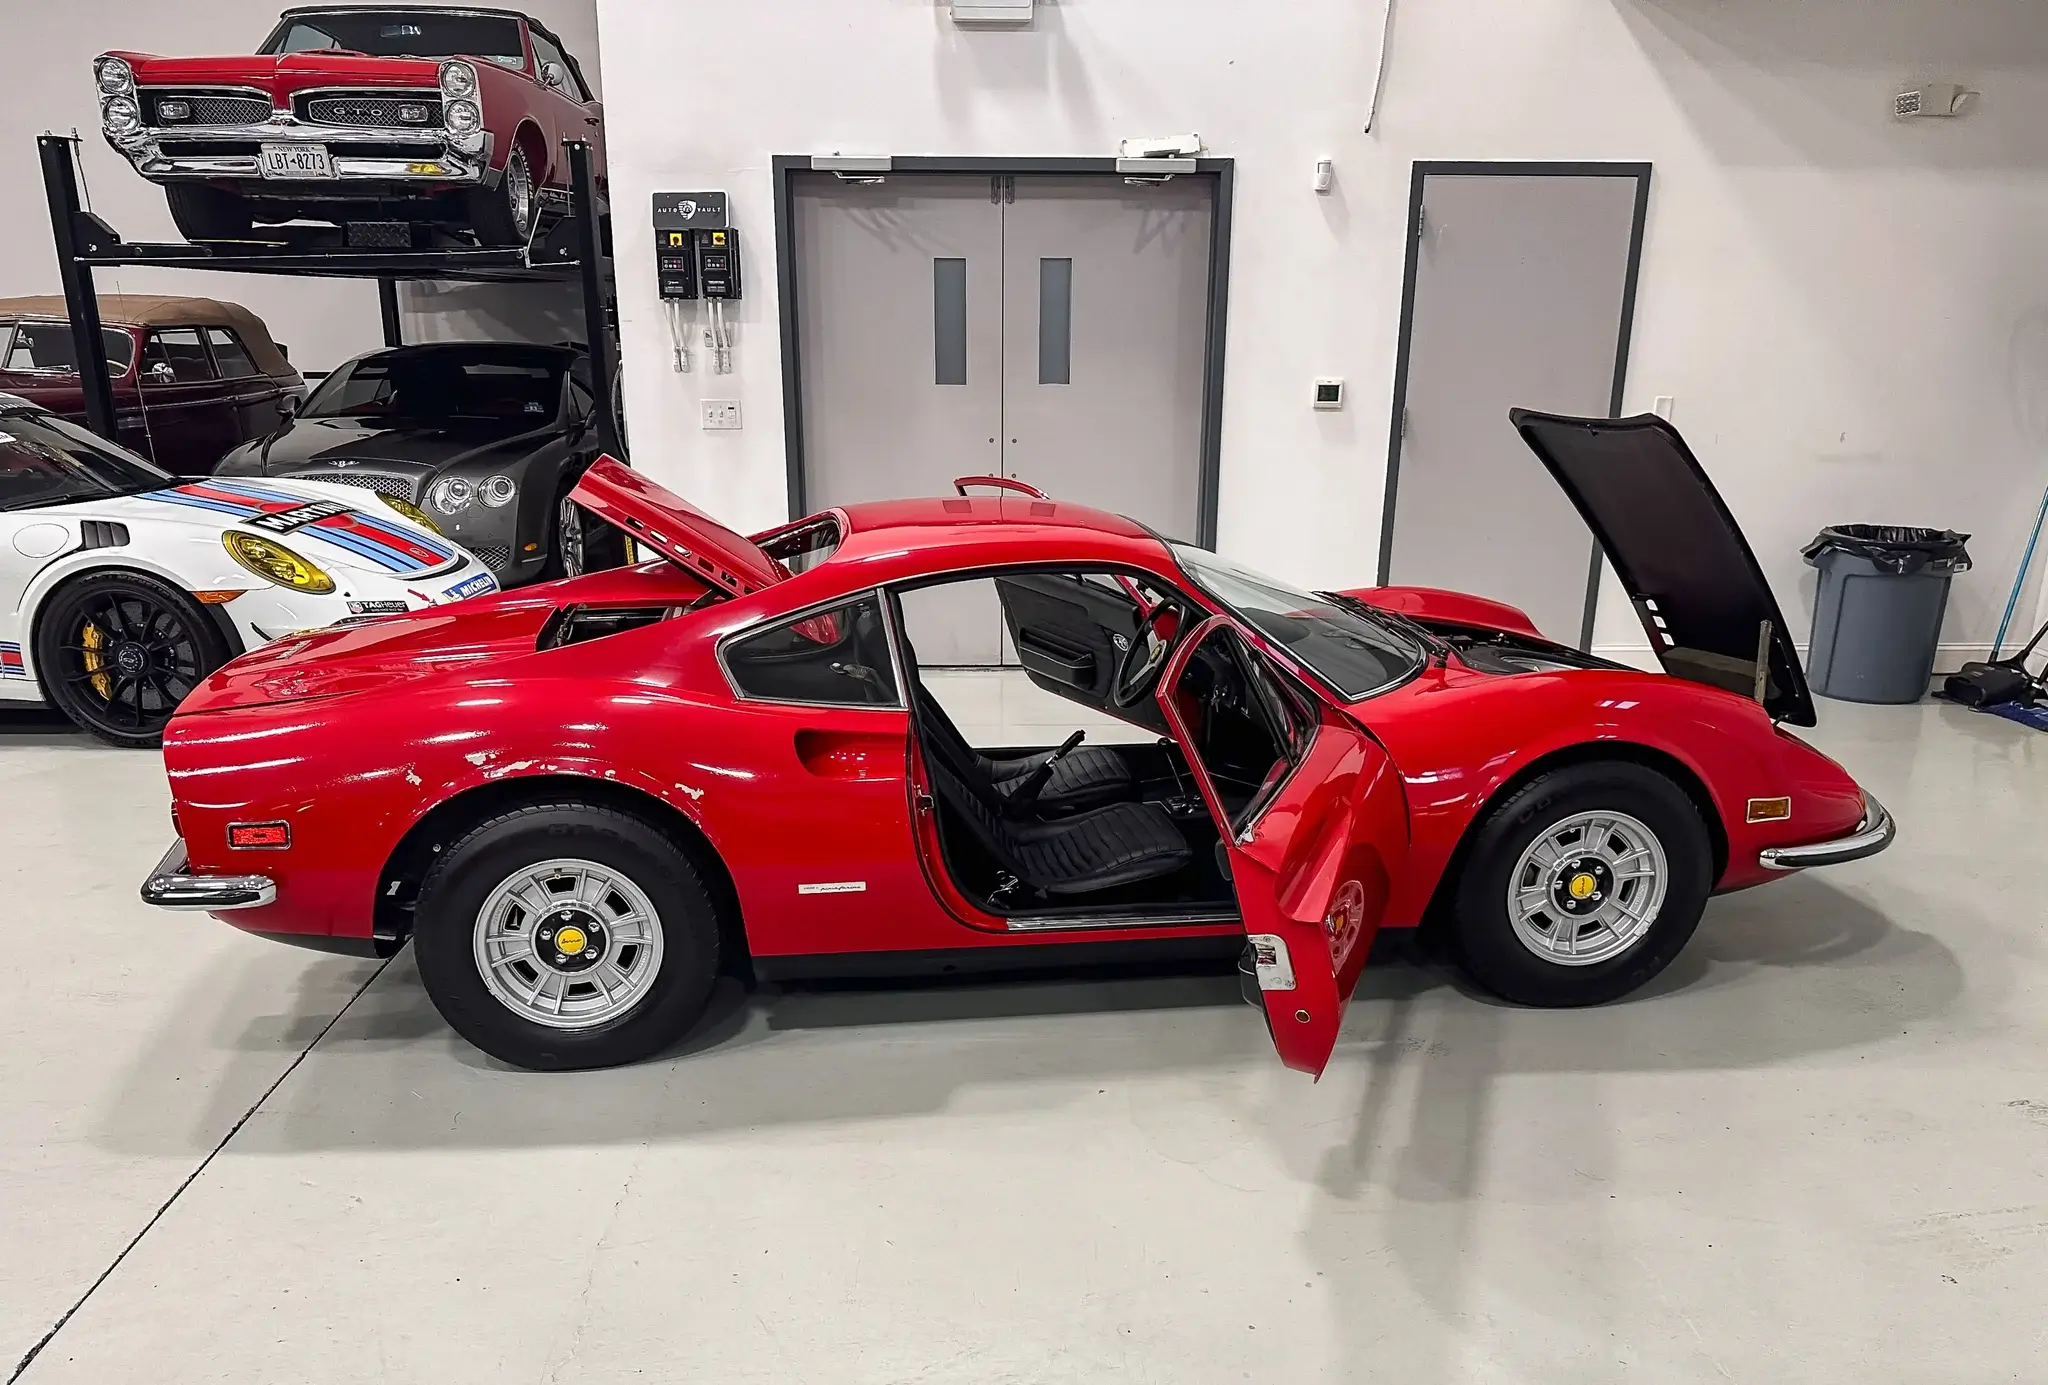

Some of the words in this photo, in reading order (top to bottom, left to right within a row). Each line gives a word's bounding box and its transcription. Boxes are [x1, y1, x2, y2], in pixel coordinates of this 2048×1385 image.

[333, 107, 383, 116] GTO
[268, 153, 290, 170] LBT
[296, 153, 325, 170] 8273
[256, 500, 352, 531] MARTINI
[460, 575, 494, 597] MICHELIN
